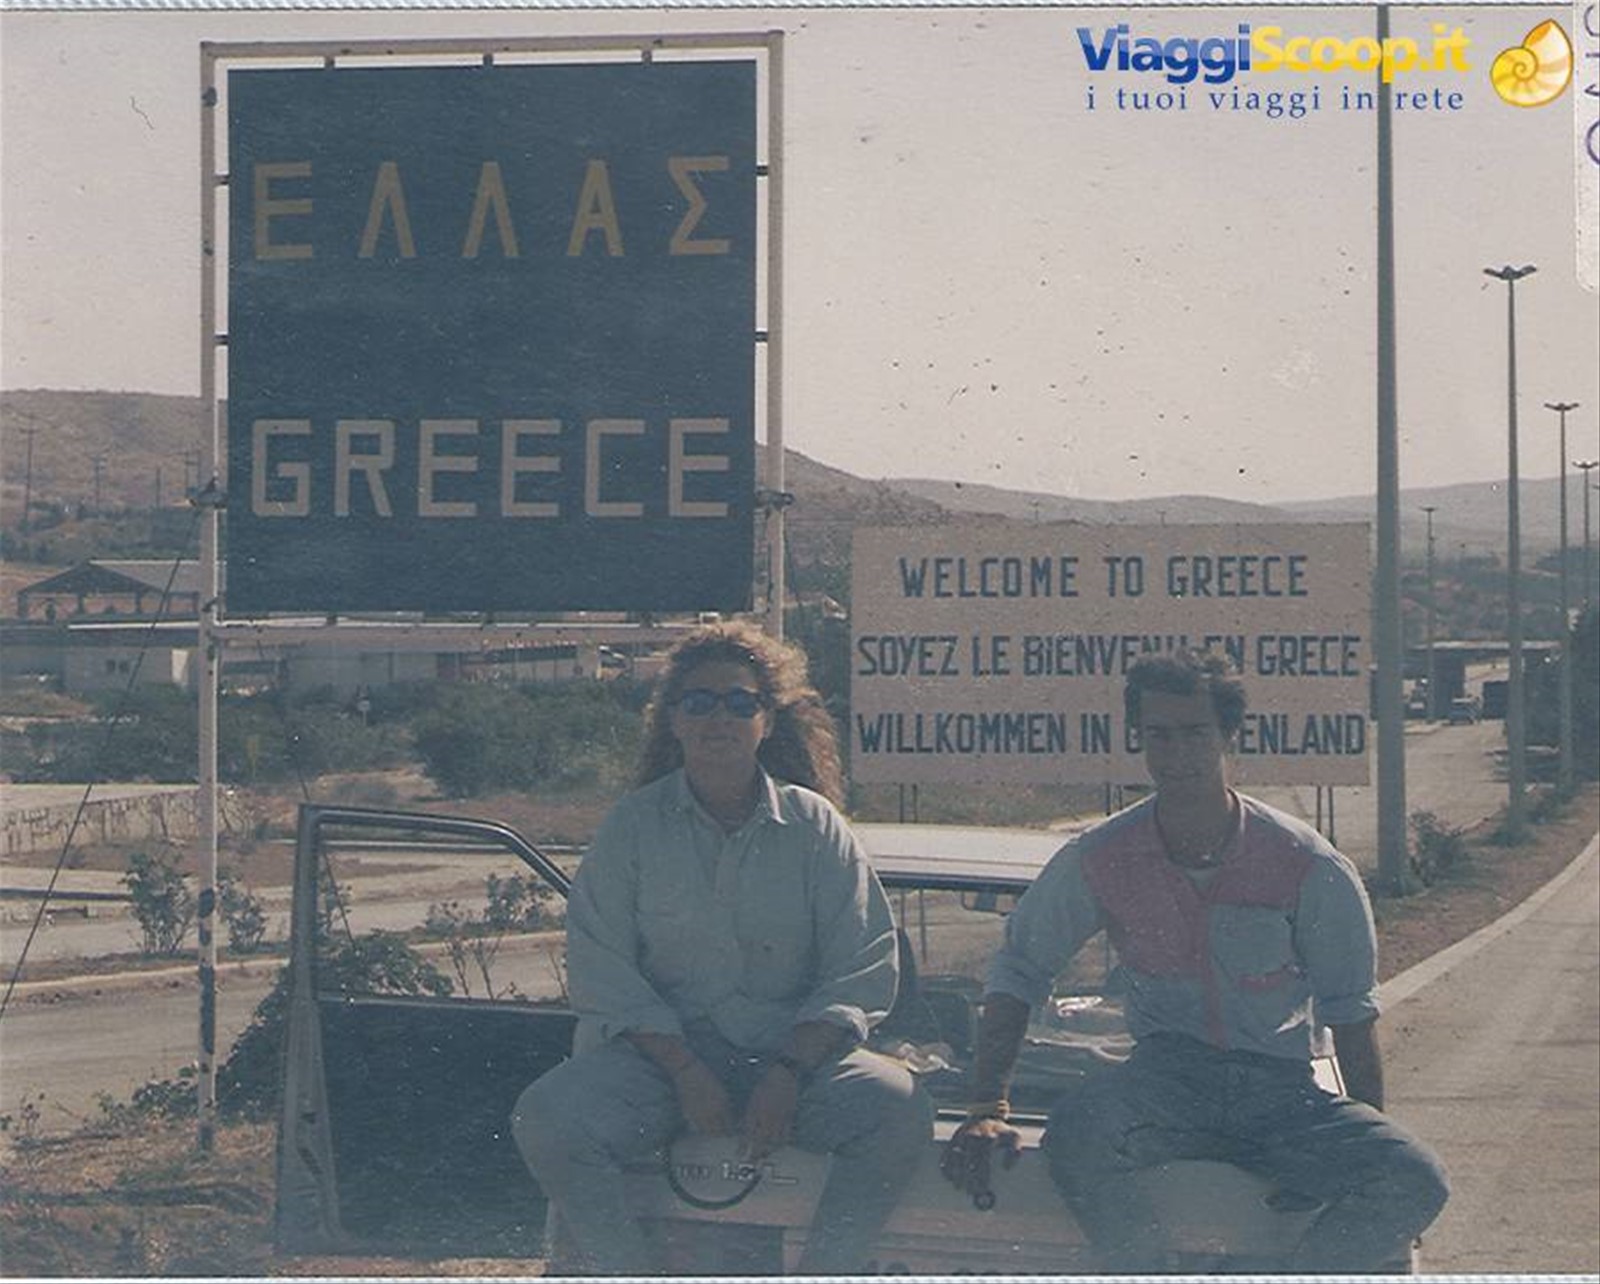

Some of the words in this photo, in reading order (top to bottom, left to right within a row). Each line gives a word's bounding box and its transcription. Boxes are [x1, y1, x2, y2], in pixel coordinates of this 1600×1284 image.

[253, 156, 730, 260] ΕΛΛΑΣ
[251, 418, 730, 518] GREECE
[899, 556, 1080, 598] WELCOME
[1103, 556, 1144, 598] TO
[1167, 555, 1309, 598] GREECE
[857, 635, 960, 677] SOYEZ
[972, 635, 1011, 677] LE
[1256, 635, 1362, 677] GRECE
[856, 713, 1067, 755] WILLKOMMEN
[1080, 713, 1112, 755] IN
